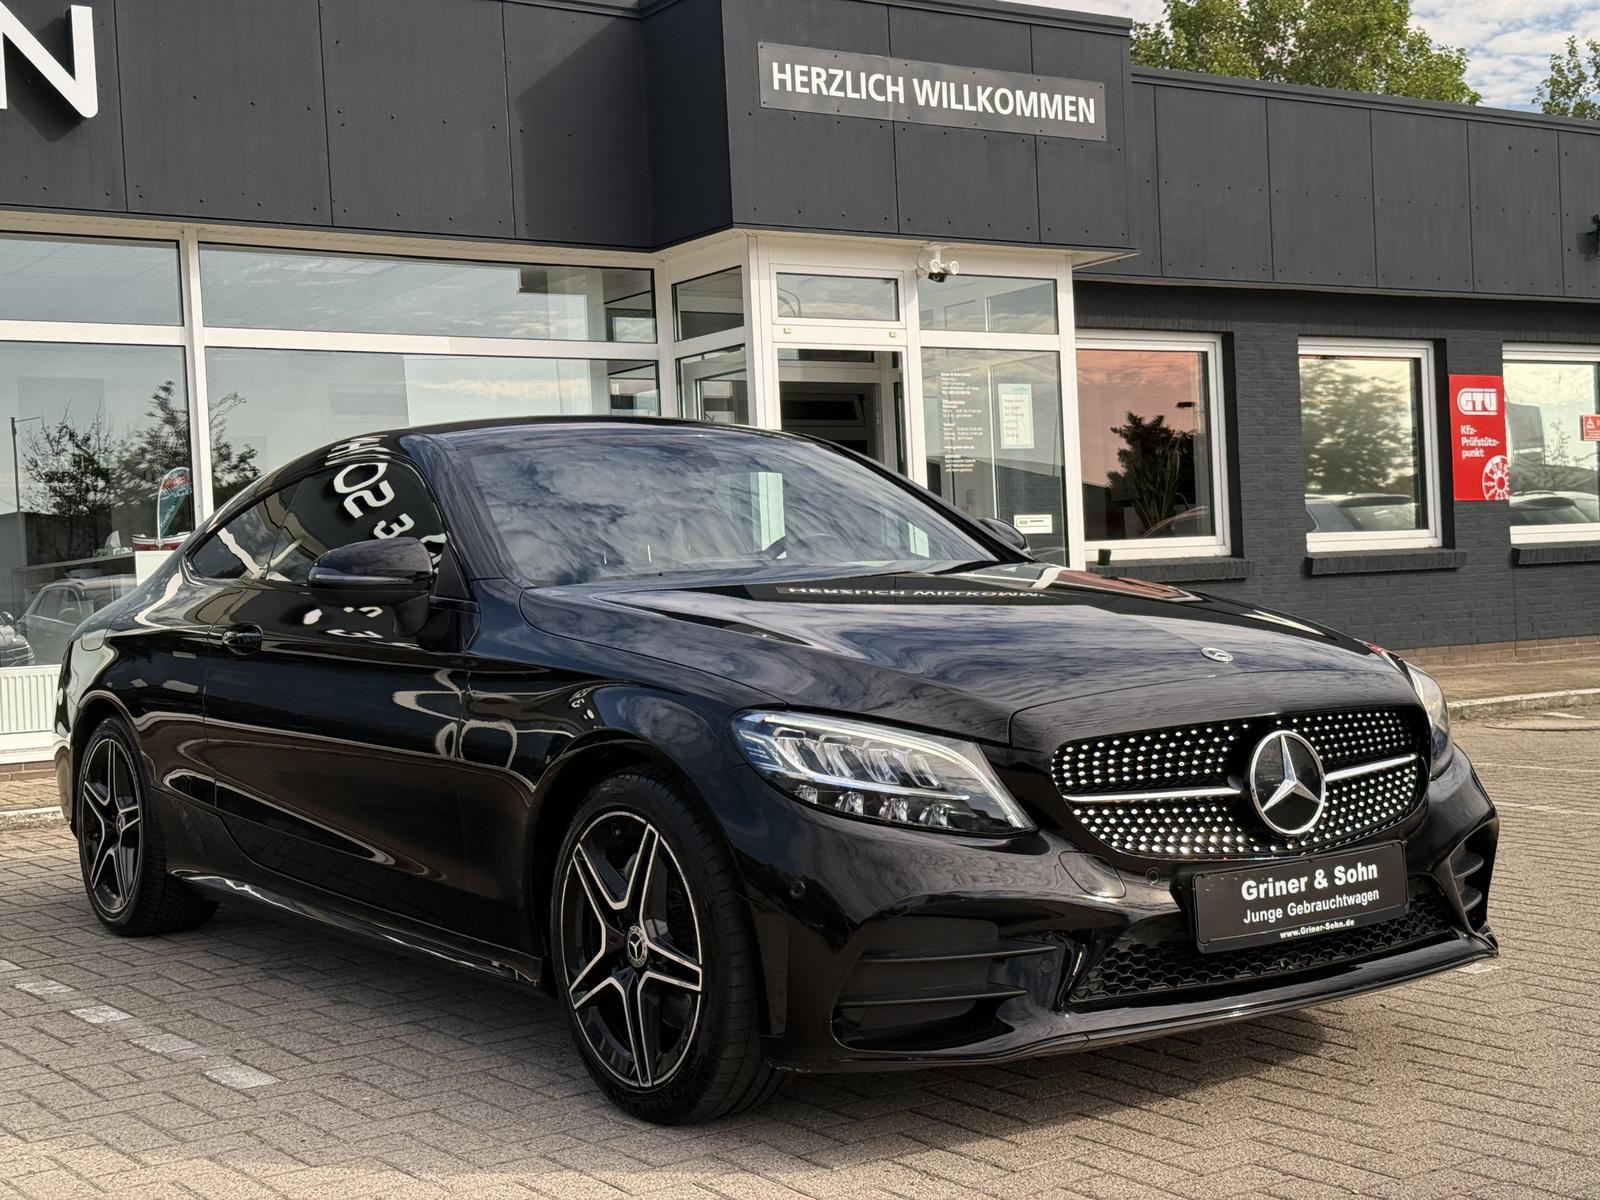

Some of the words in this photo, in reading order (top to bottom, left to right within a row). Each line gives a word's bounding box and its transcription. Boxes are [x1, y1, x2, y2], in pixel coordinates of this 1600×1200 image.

[0, 2, 98, 118] N
[772, 62, 904, 104] HERZLICH
[912, 78, 1096, 124] WILLKOMMEN
[1460, 424, 1477, 435] Kfz-
[1461, 447, 1485, 460] punkt
[1241, 876, 1308, 900] Griner
[1313, 868, 1329, 890] &
[1334, 861, 1378, 886] Sohn
[1243, 907, 1283, 923] Junge
[1287, 889, 1380, 916] Gebrauchtwagen
[1279, 918, 1355, 939] www.Griner-Sohn.de
